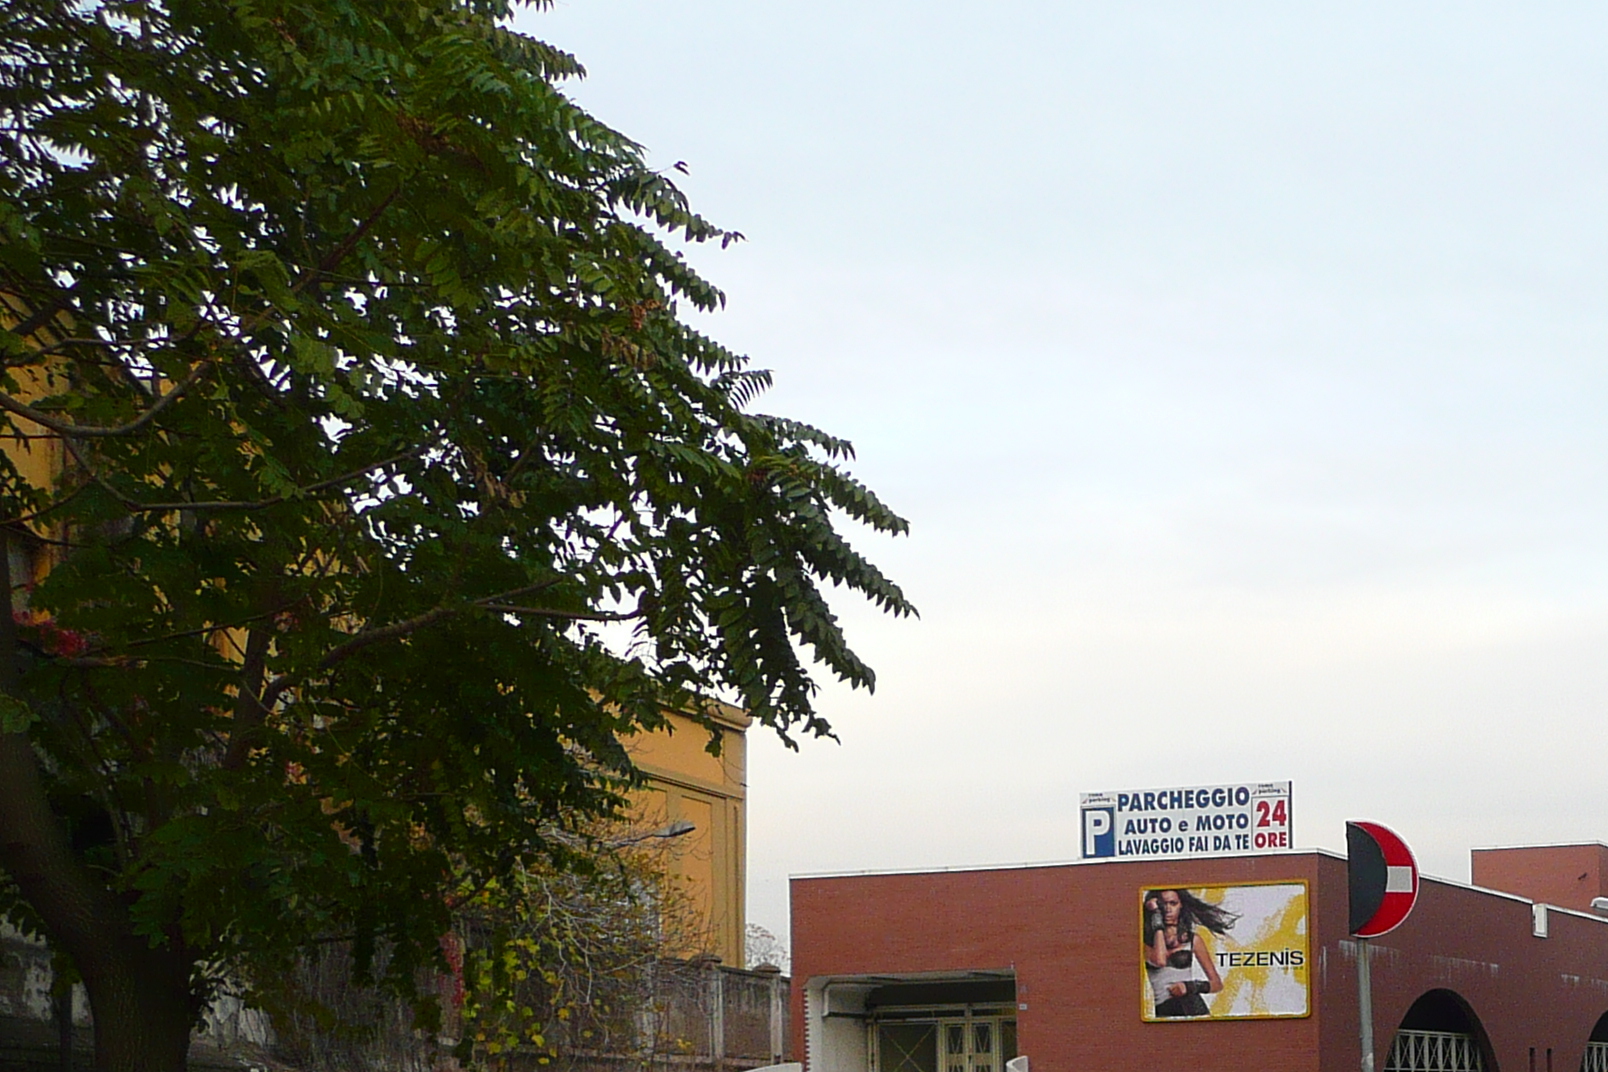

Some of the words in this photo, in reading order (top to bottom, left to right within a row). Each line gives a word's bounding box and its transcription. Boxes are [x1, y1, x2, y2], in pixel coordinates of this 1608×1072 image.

[1117, 786, 1250, 812] PARCHEGGIO
[1124, 818, 1171, 835] AUTO
[1178, 820, 1189, 832] e
[1196, 813, 1249, 831] MOTO
[1256, 799, 1287, 828] 24
[1085, 809, 1110, 855] P
[1254, 832, 1287, 849] ORE
[1118, 837, 1184, 856] LAVAGGIO
[1189, 836, 1209, 852] FAI
[1213, 835, 1231, 851] DA
[1235, 834, 1250, 850] TE
